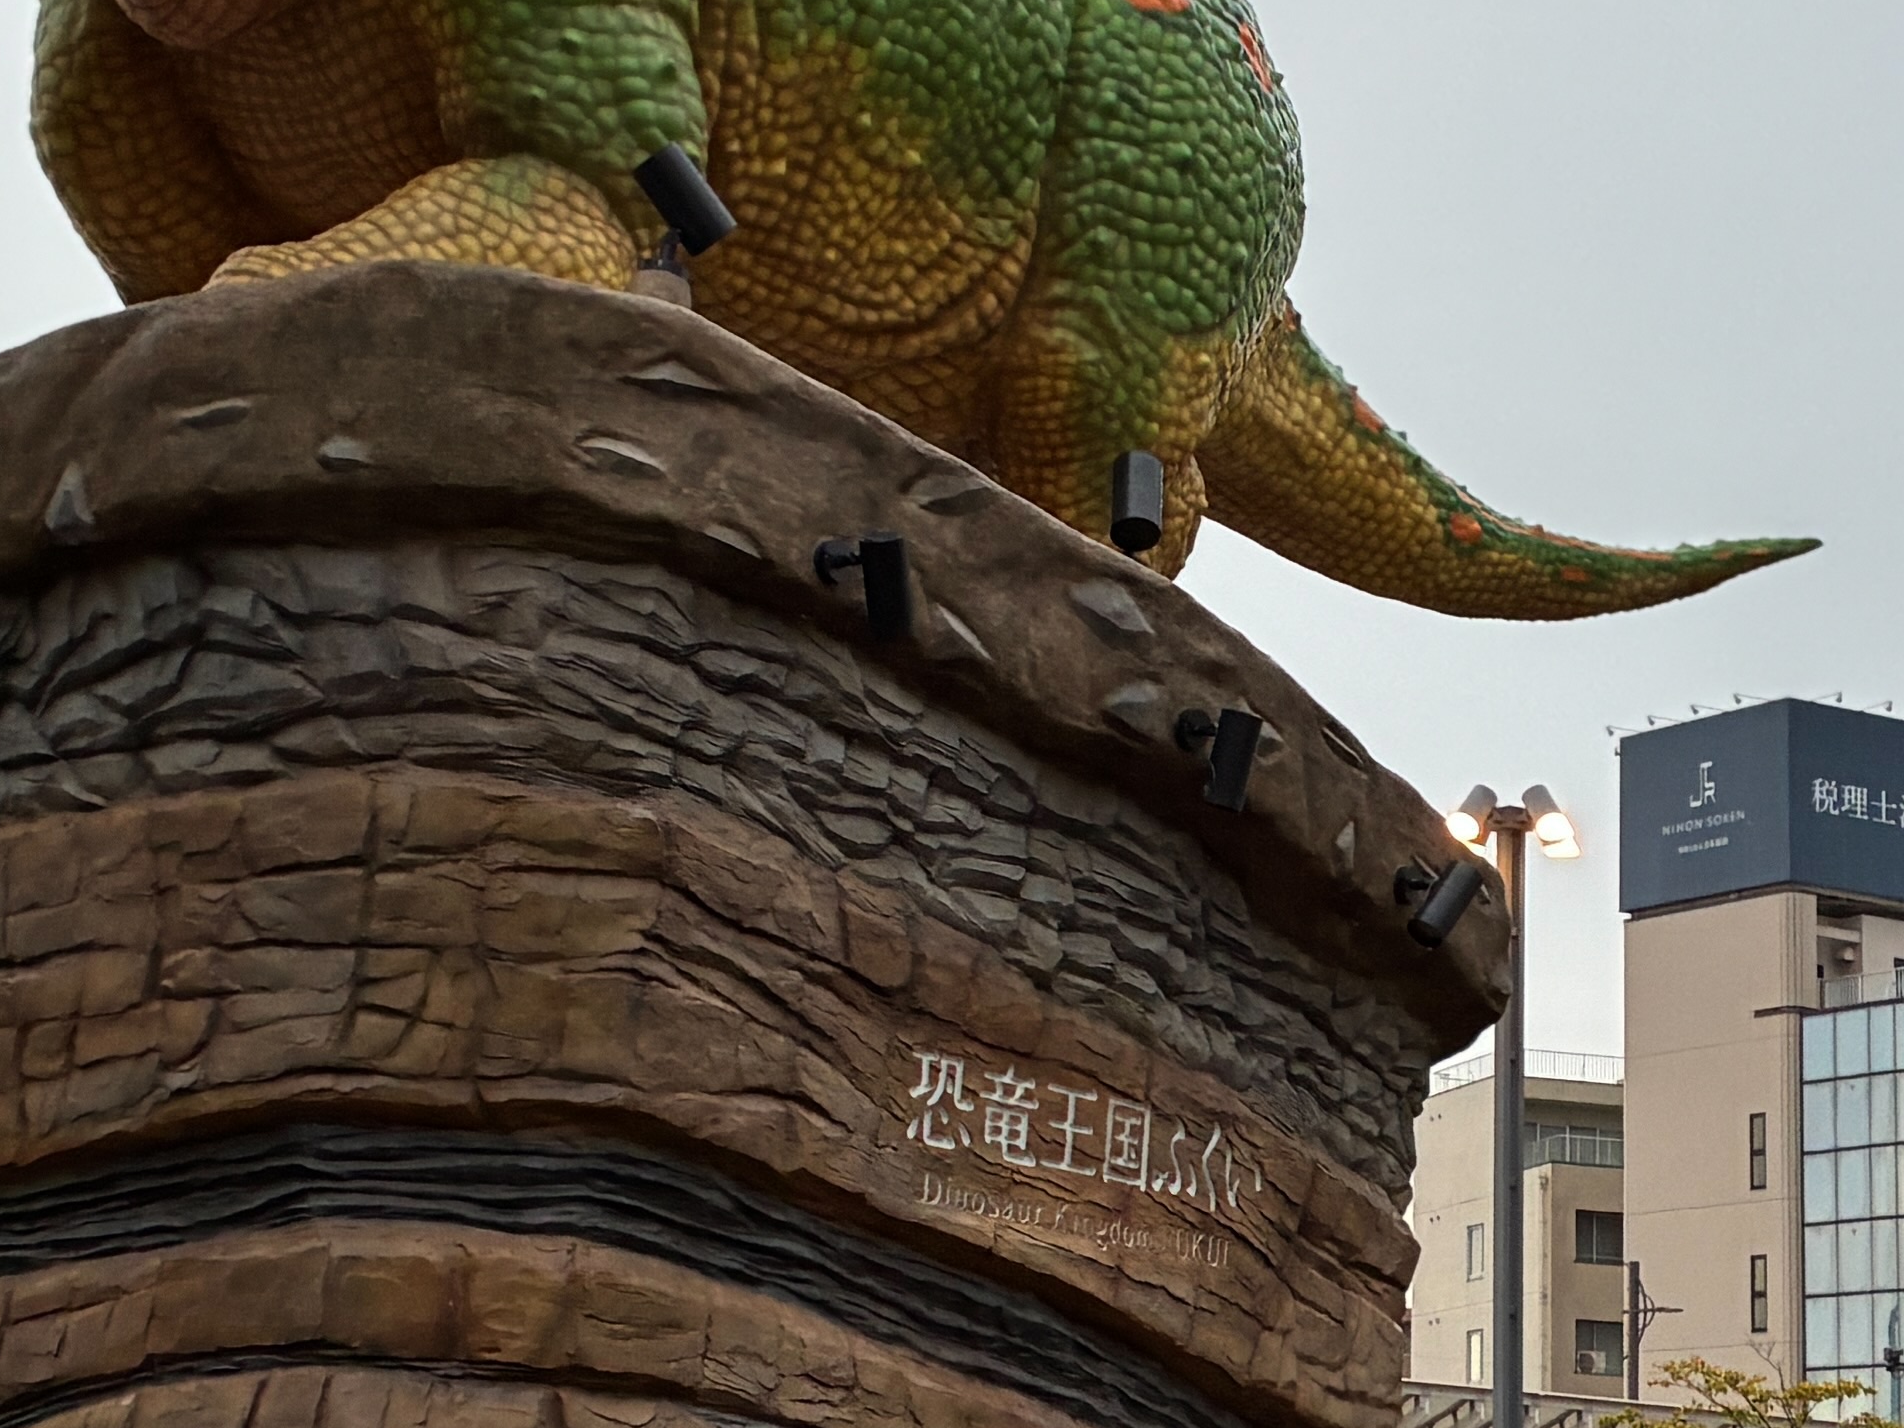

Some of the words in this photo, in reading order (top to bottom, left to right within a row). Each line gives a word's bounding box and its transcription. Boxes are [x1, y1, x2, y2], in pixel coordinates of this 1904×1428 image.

[907, 1052, 1262, 1213] 恐竜王国ふくい
[916, 1173, 1043, 1223] Dinosaur
